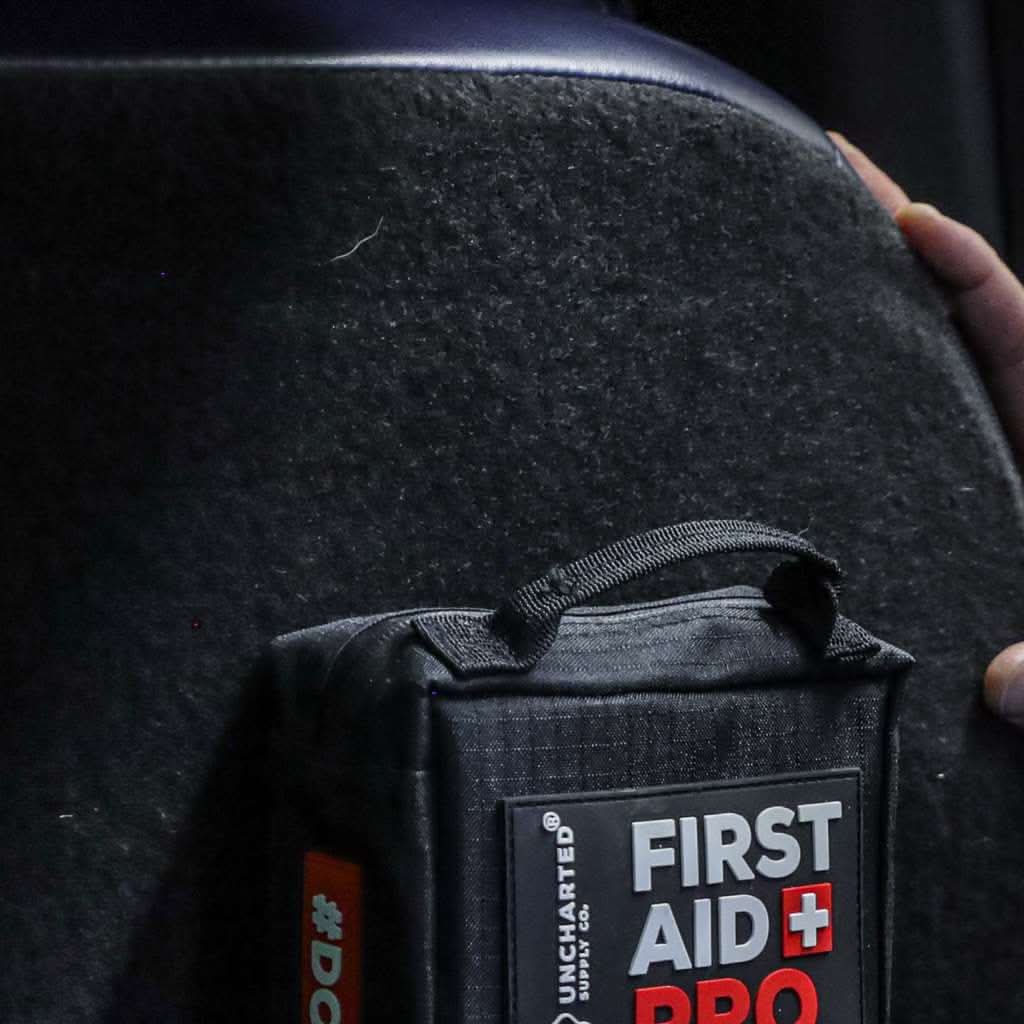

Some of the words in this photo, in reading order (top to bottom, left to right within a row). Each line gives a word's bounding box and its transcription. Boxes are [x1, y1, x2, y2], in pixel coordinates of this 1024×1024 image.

[631, 801, 843, 892] FIRST
[579, 903, 590, 932] CO.
[628, 894, 770, 976] AID
[578, 939, 590, 1001] SUPPLY
